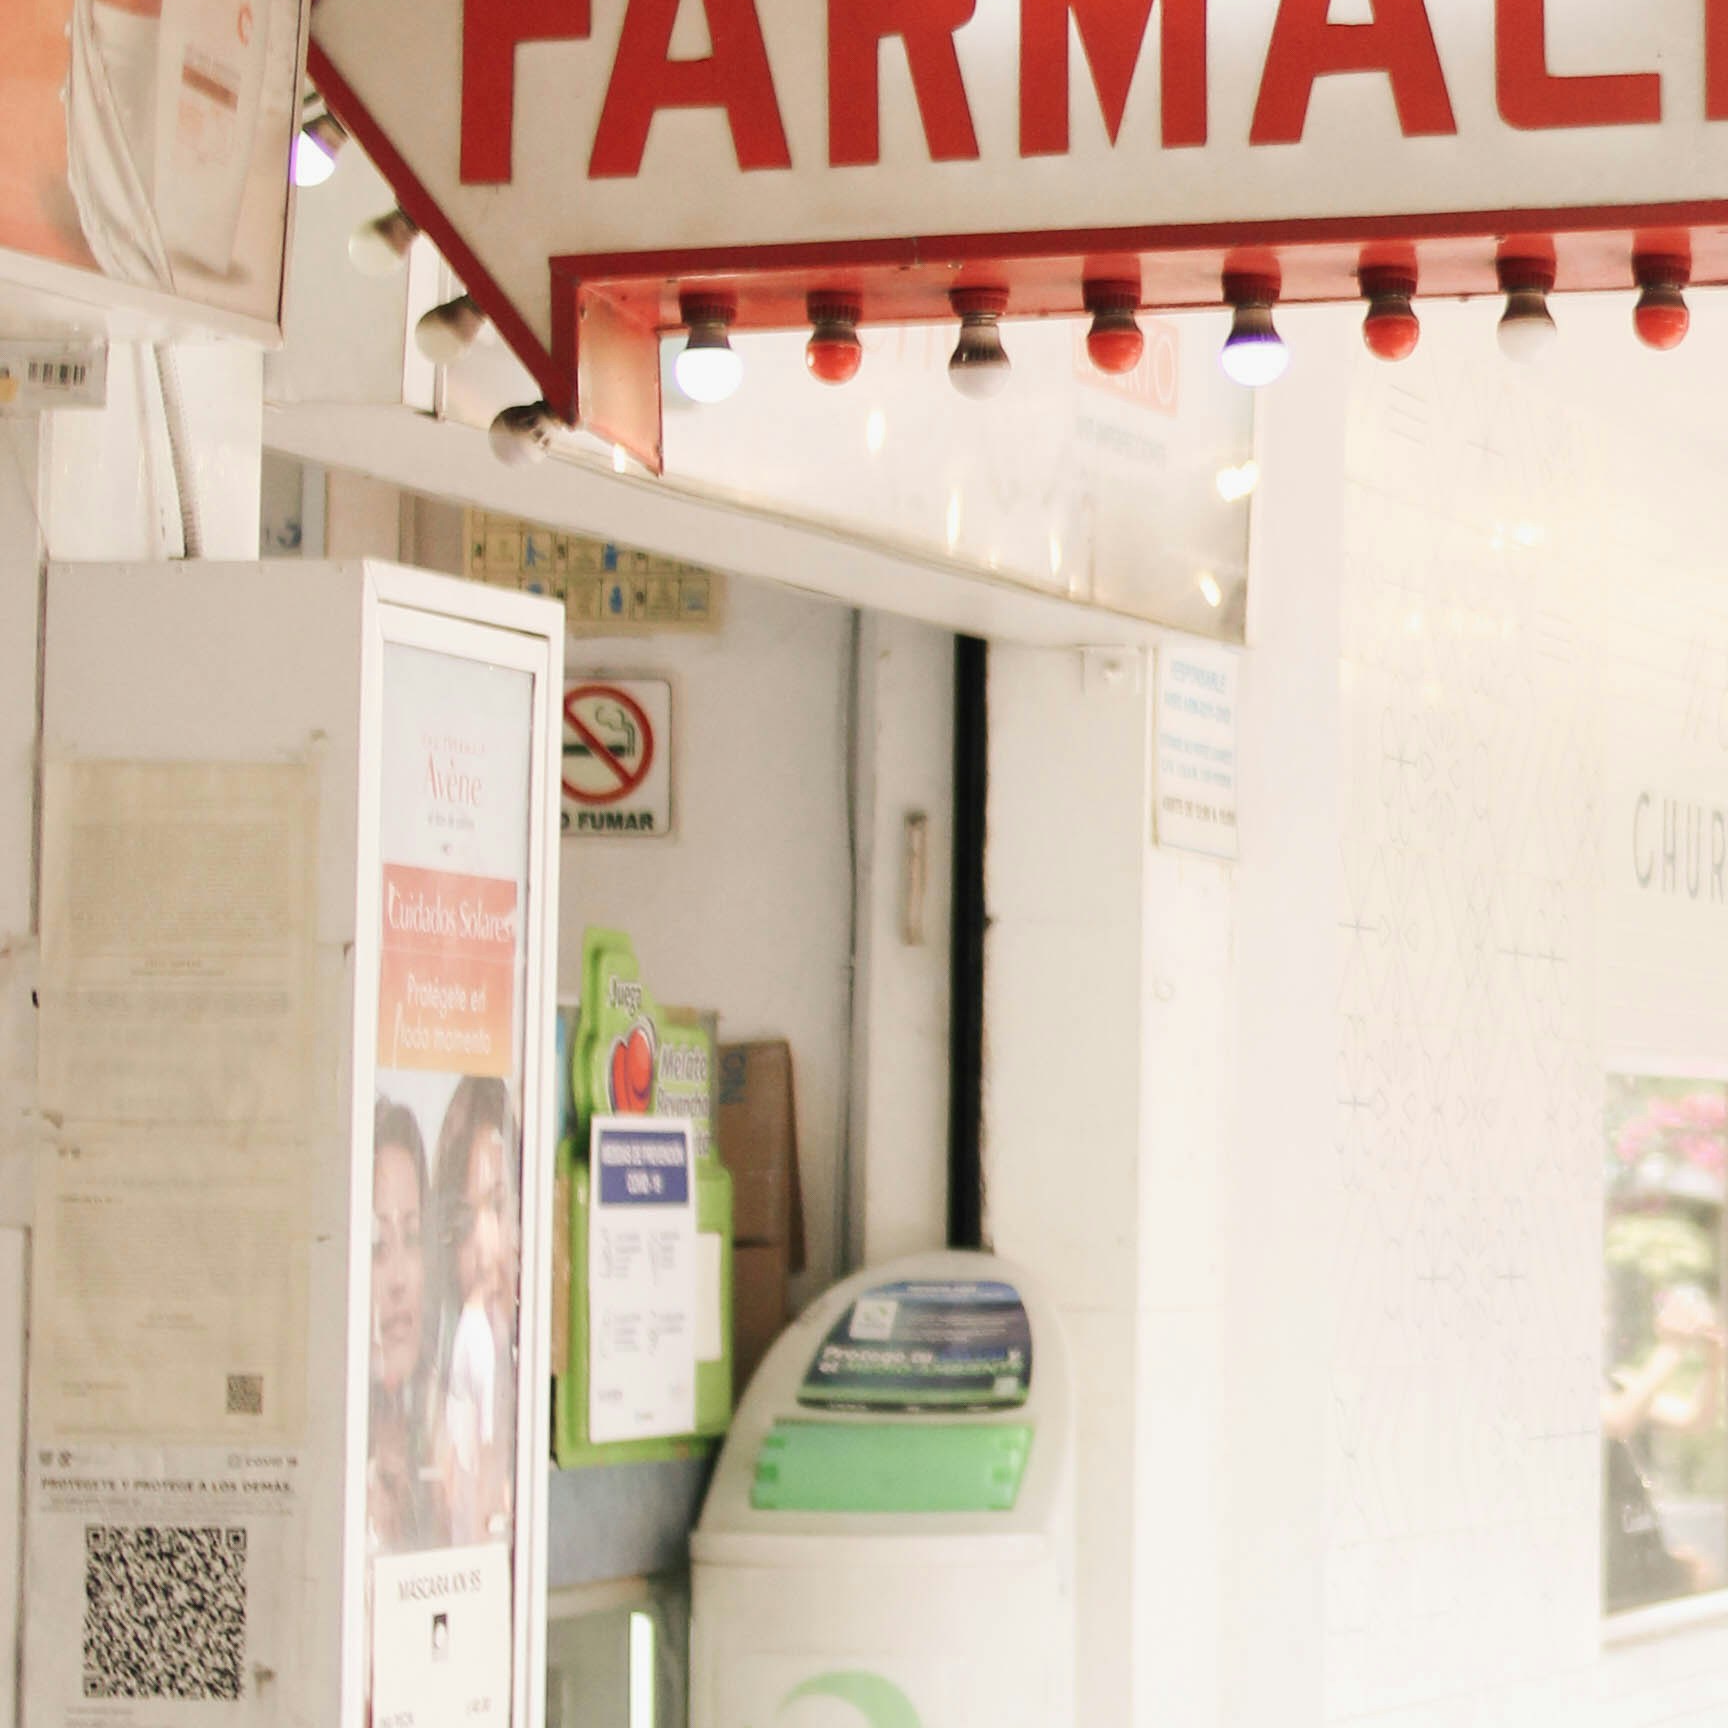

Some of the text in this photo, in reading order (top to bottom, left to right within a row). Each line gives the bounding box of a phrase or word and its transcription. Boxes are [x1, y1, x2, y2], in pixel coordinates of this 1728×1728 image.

[426, 752, 483, 808] Avène
[577, 811, 654, 830] FUMAR
[388, 885, 513, 942] Cuidados Solares
[608, 978, 642, 1016] Juega
[658, 1044, 708, 1081] Melate
